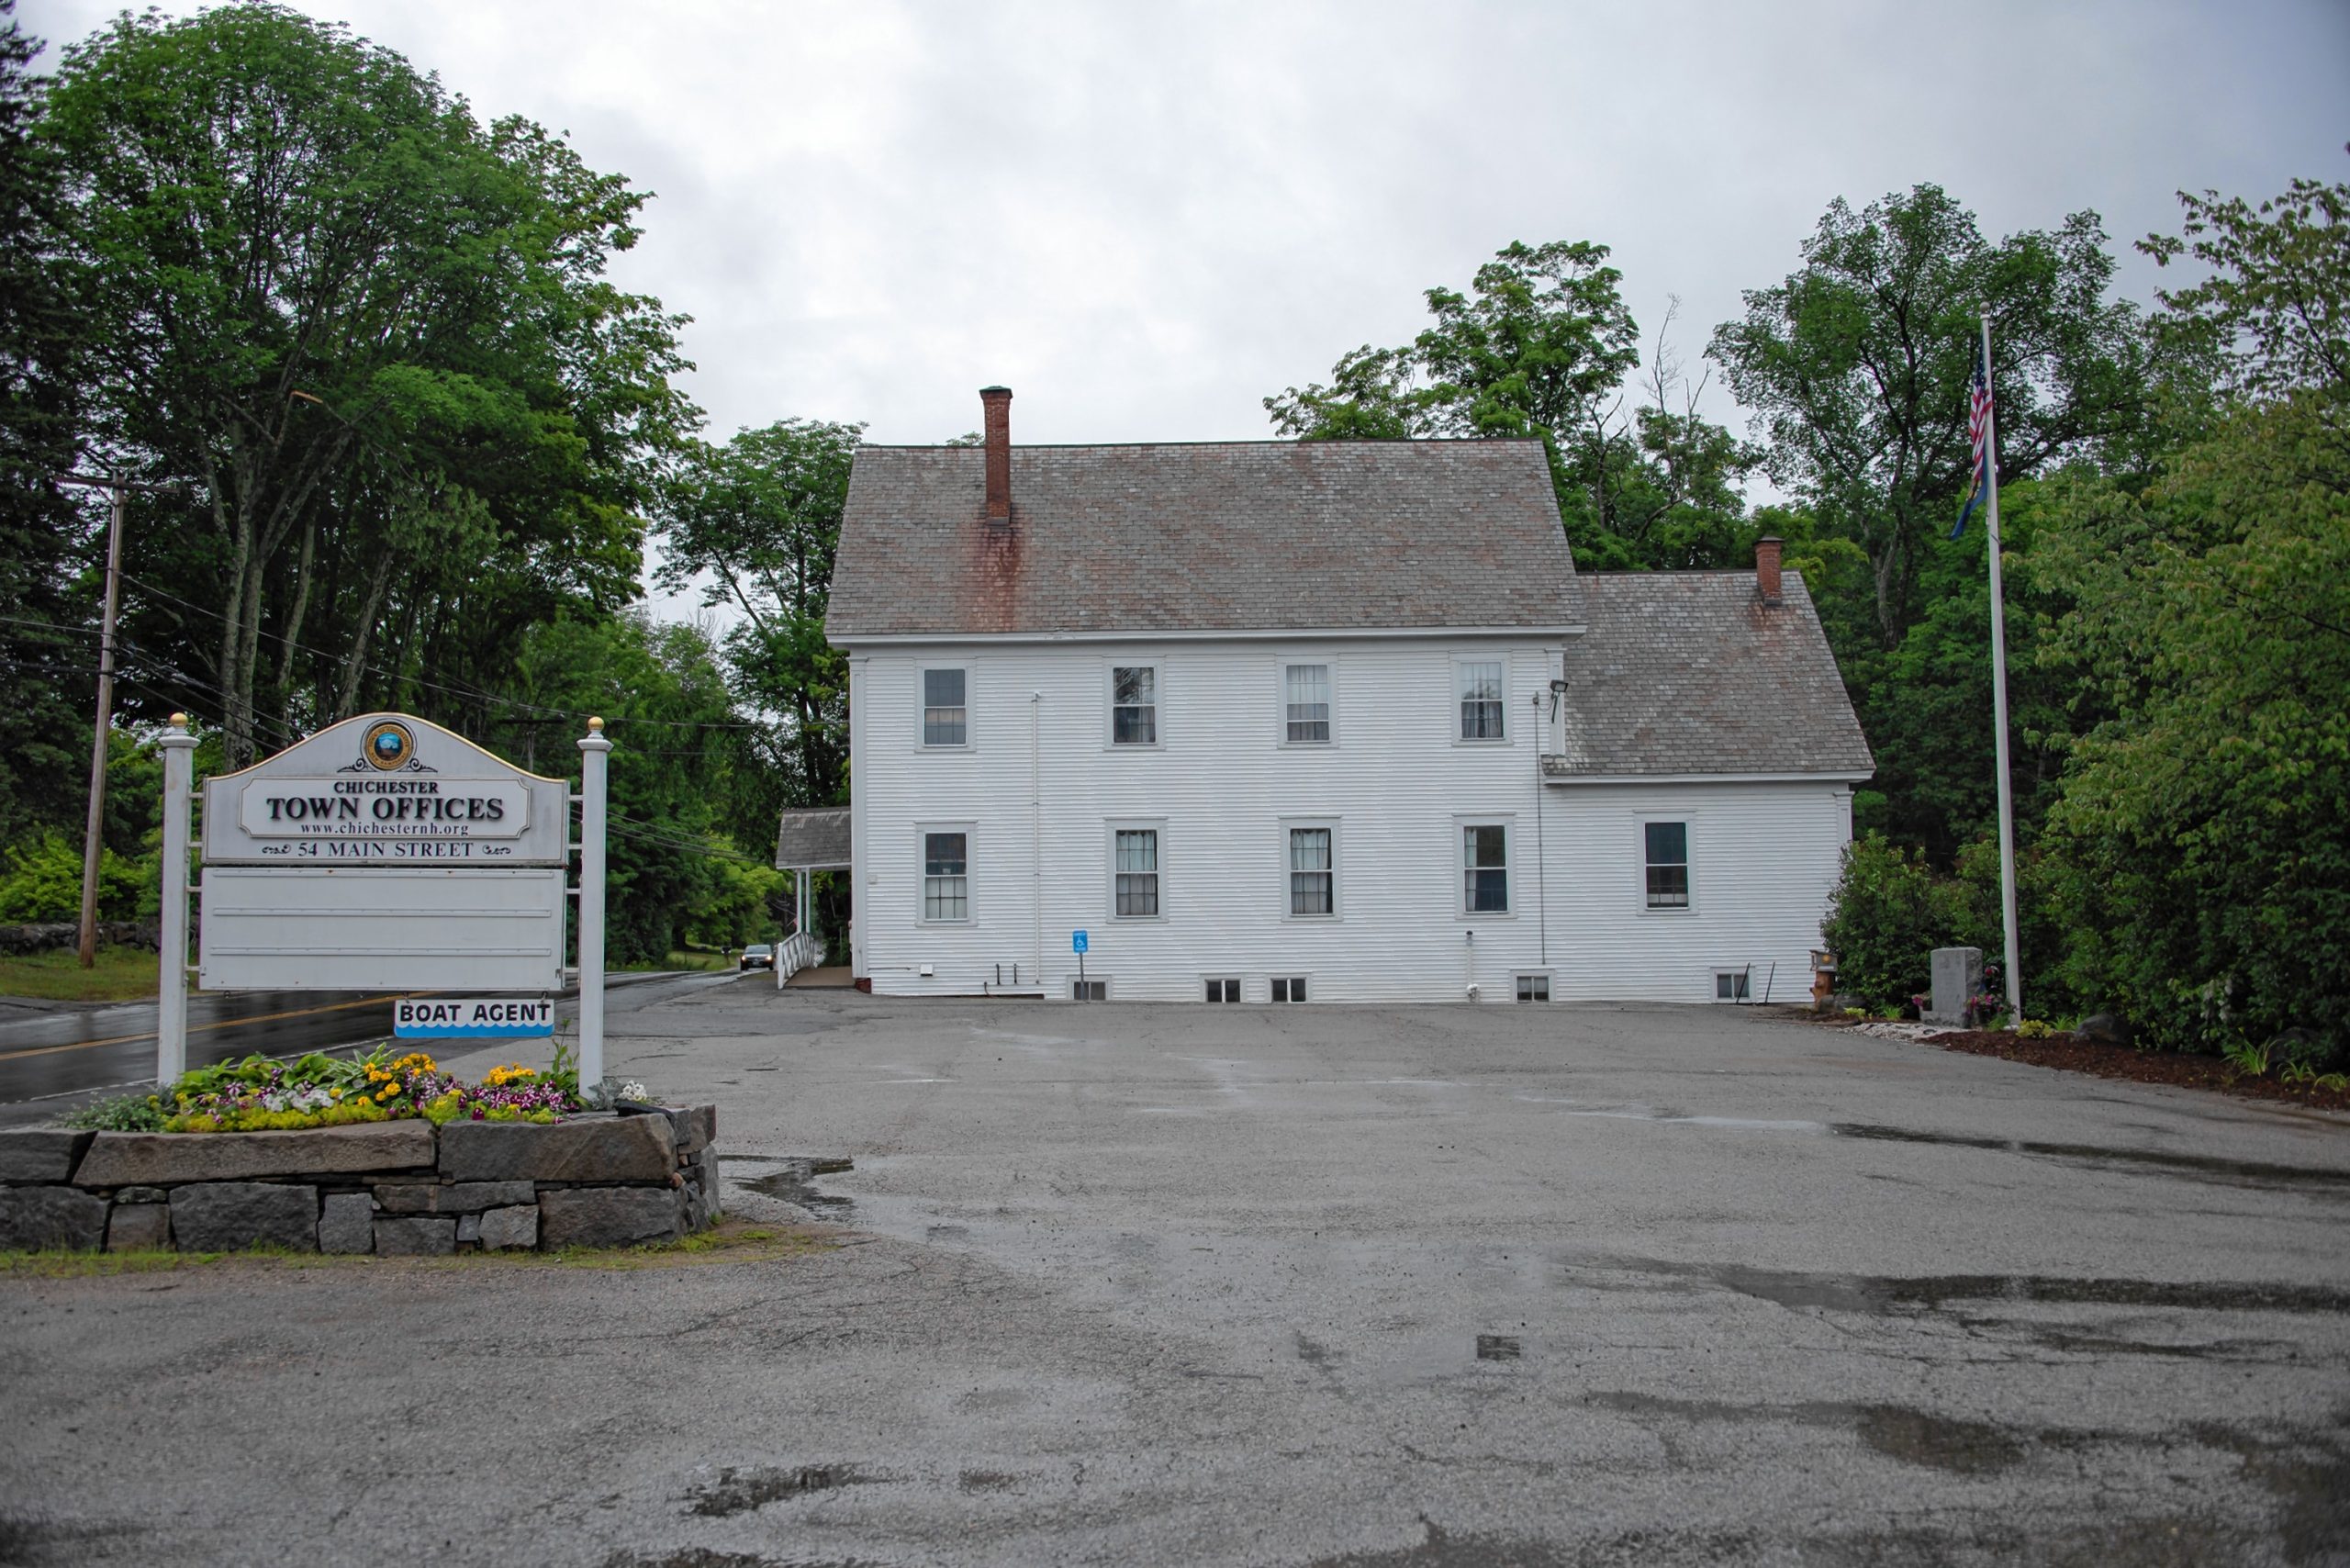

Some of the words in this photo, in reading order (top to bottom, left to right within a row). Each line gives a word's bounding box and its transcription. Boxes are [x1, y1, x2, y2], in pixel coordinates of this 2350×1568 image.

[333, 781, 440, 794] CHICHESTER
[266, 797, 361, 821] TOWN
[372, 797, 505, 821] OFFICES
[301, 822, 469, 836] www.chichesternh.org
[297, 842, 319, 857] 54
[328, 842, 386, 857] MAIN
[395, 842, 475, 857] STREET
[399, 1004, 462, 1022] BOAT
[473, 1003, 552, 1022] AGENT
